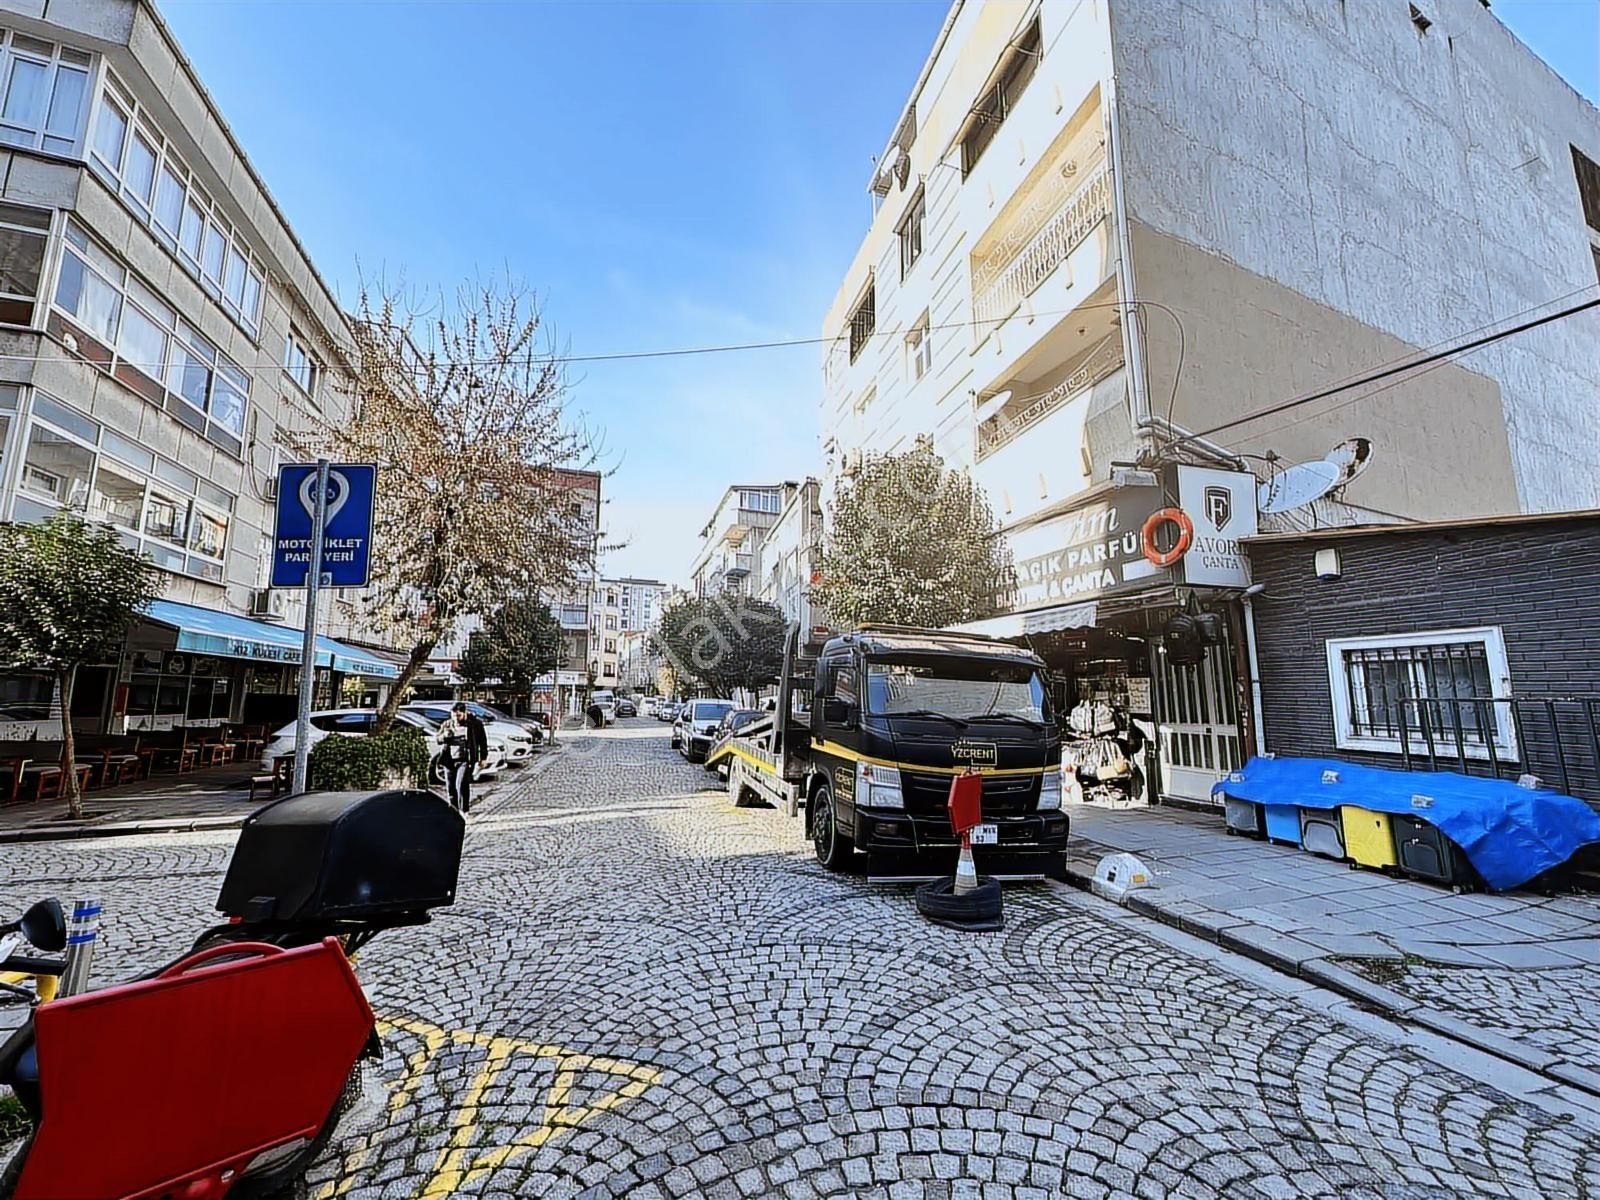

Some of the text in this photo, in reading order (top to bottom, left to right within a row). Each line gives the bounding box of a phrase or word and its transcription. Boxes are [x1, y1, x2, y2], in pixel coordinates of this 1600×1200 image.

[278, 537, 363, 549] MOTOİKLET
[1195, 536, 1239, 556] AVOR
[284, 550, 354, 562] PAR YERİ
[1018, 554, 1061, 583] AÇIK
[1068, 531, 1144, 569] PARFÜ
[1202, 555, 1240, 570] ÇANTA
[1062, 567, 1116, 598] ÇANTA
